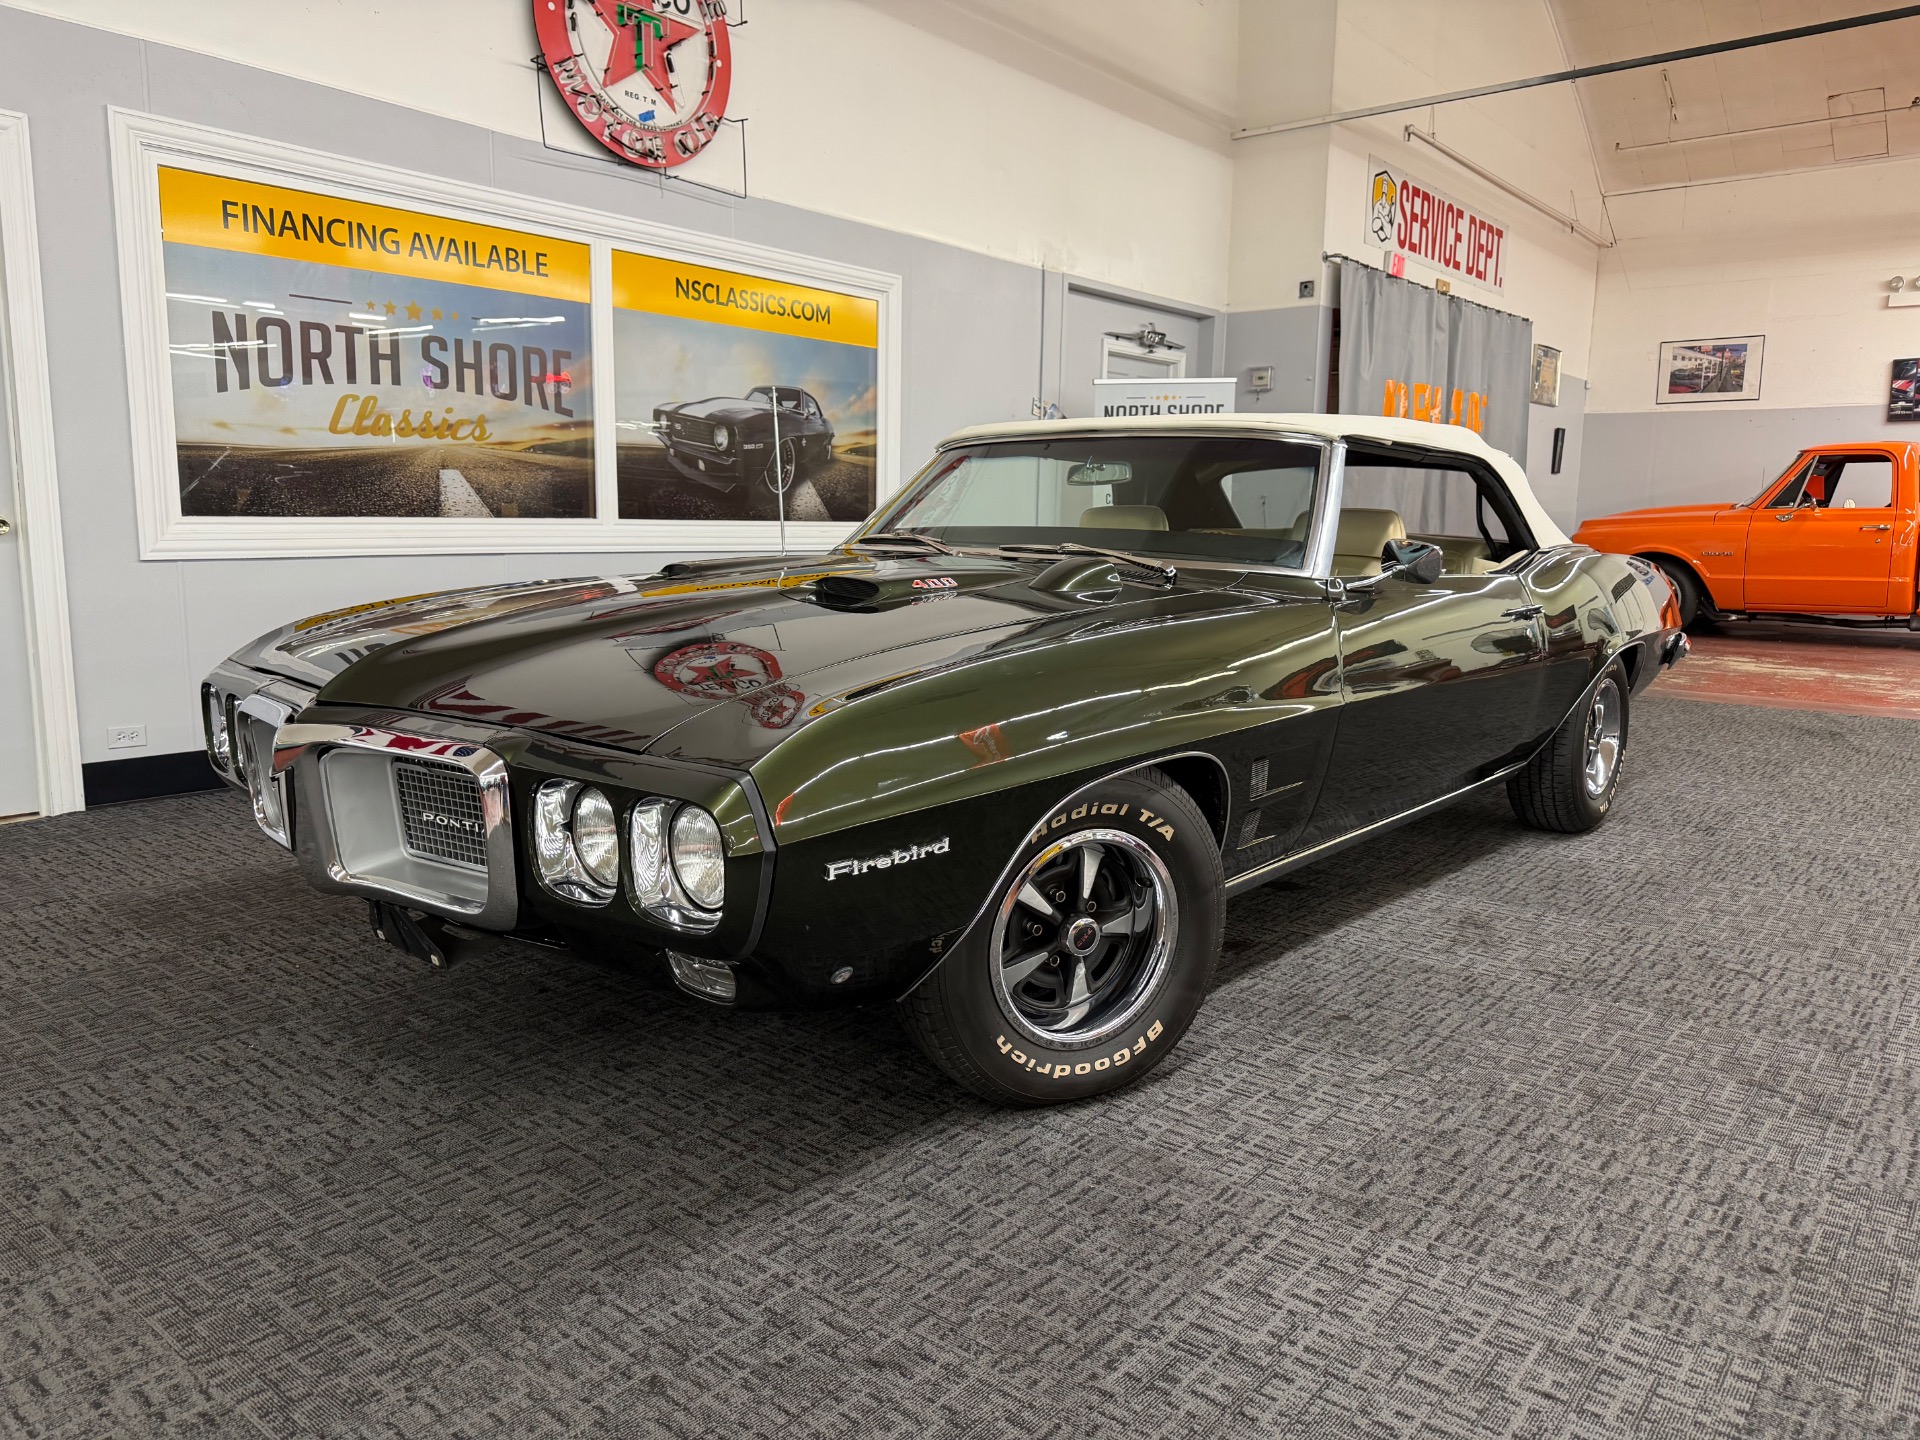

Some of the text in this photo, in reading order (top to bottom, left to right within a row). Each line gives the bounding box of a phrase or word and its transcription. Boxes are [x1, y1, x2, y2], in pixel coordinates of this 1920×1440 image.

[221, 199, 549, 278] FINANCING AVAILABLE
[1397, 180, 1504, 288] SERVICE DEPT.
[675, 276, 832, 325] NSCLASSICS.COM
[211, 310, 575, 418] NORTH SHORE
[328, 393, 493, 442] Classics
[911, 577, 958, 589] 400
[423, 812, 485, 833] PONTI
[1030, 802, 1175, 845] Radial T/A
[823, 836, 951, 882] Firebird
[996, 1019, 1164, 1079] BFGoodrich
